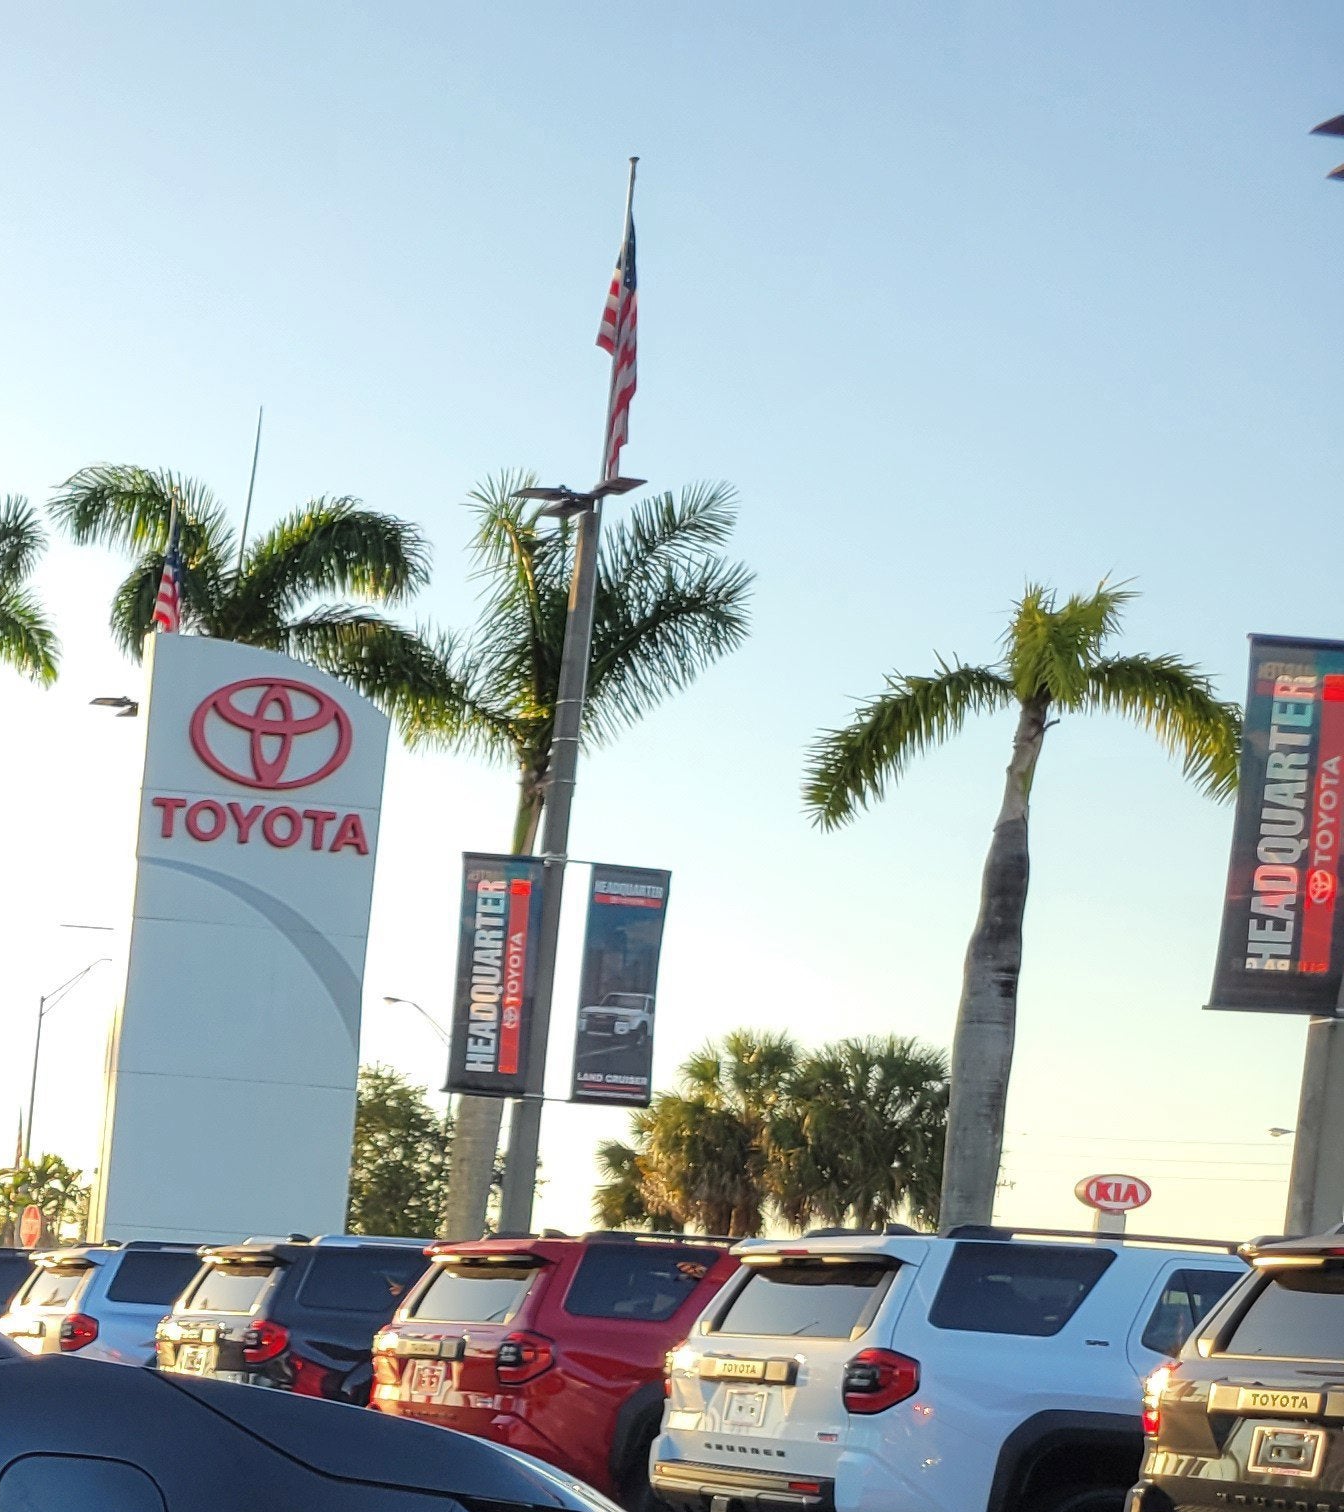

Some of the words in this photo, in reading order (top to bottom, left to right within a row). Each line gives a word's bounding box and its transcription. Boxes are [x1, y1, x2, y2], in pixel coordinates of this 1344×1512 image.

[152, 797, 369, 856] TOYOTA
[1245, 674, 1318, 971] HEADQUARTER
[1313, 755, 1343, 866] TOYOTA
[465, 879, 508, 1073] HEADQUARTER
[506, 931, 524, 1003] TOYOTA
[577, 1071, 603, 1082] LAND
[605, 1073, 648, 1086] CRUISER
[1095, 1182, 1140, 1206] KIA
[722, 1363, 757, 1375] TOYOTA
[1252, 1393, 1309, 1409] TOYOTA
